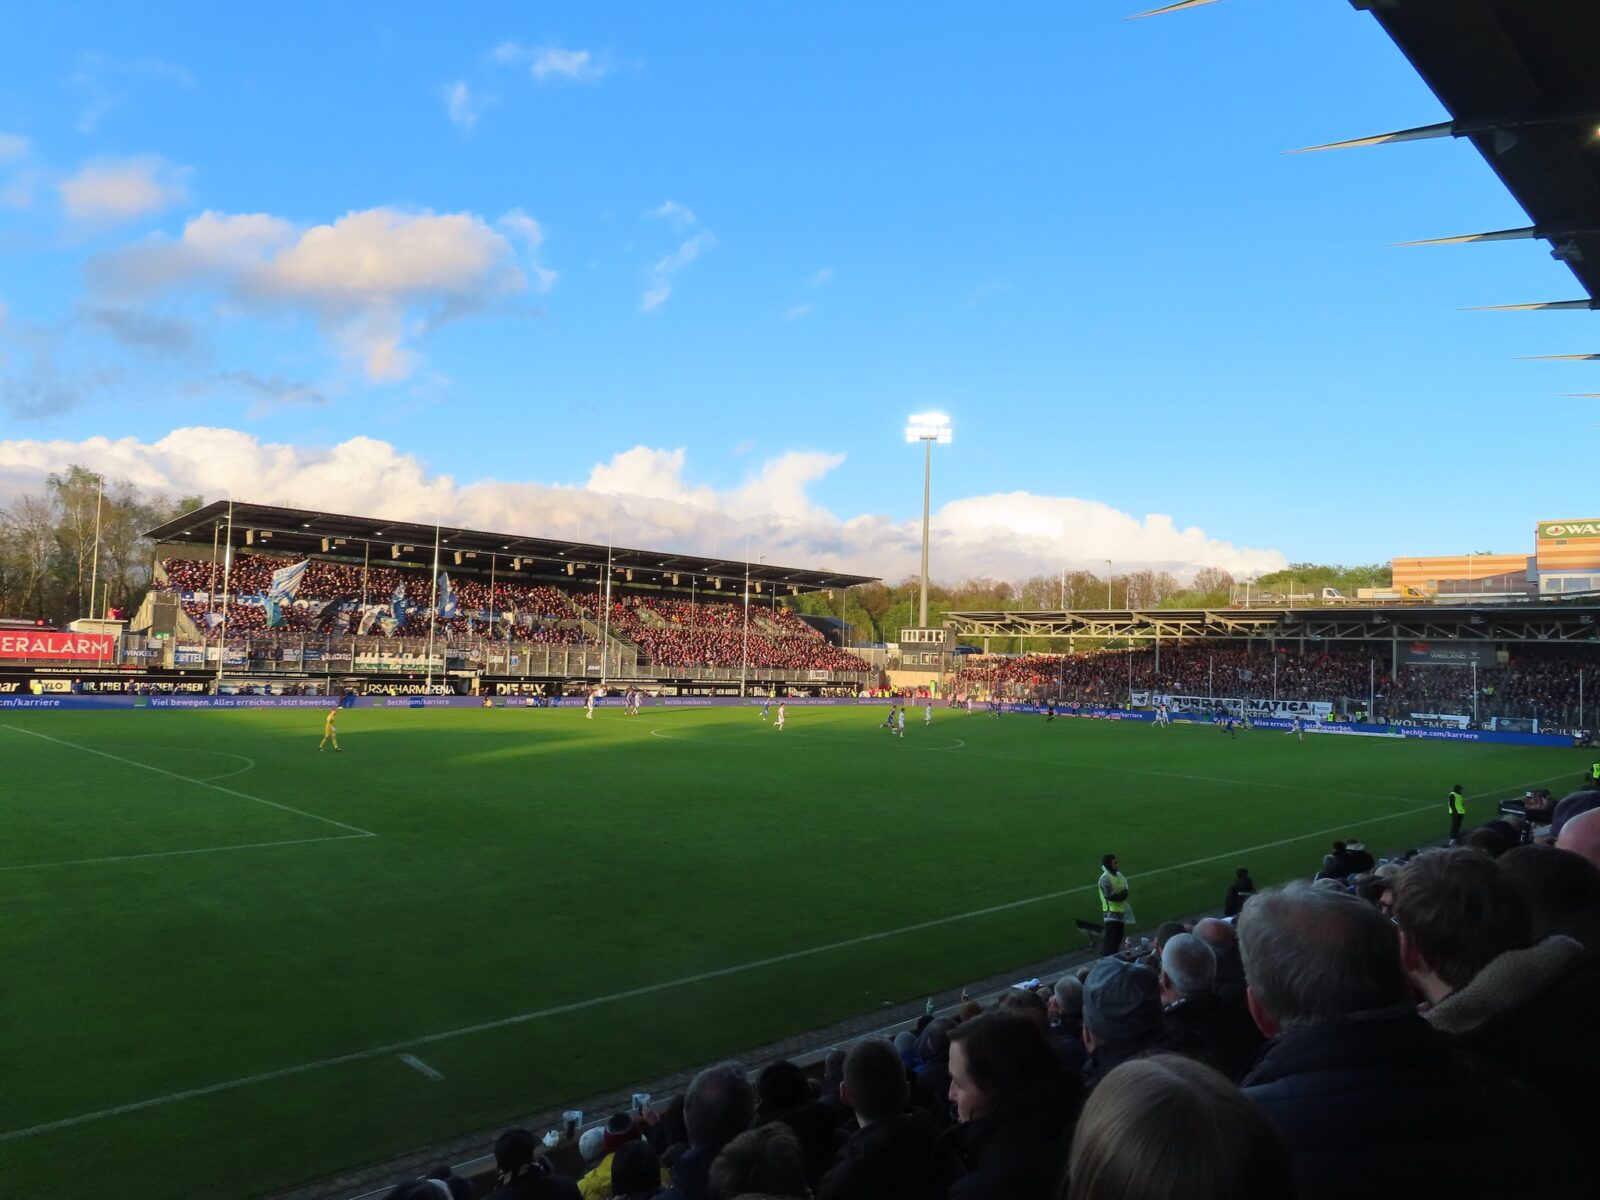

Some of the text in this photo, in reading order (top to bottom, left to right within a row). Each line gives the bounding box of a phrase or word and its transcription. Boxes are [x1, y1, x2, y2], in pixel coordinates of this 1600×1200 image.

[0, 637, 109, 655] ERALARM
[43, 682, 63, 690] YLO
[171, 699, 211, 708] bewegen.
